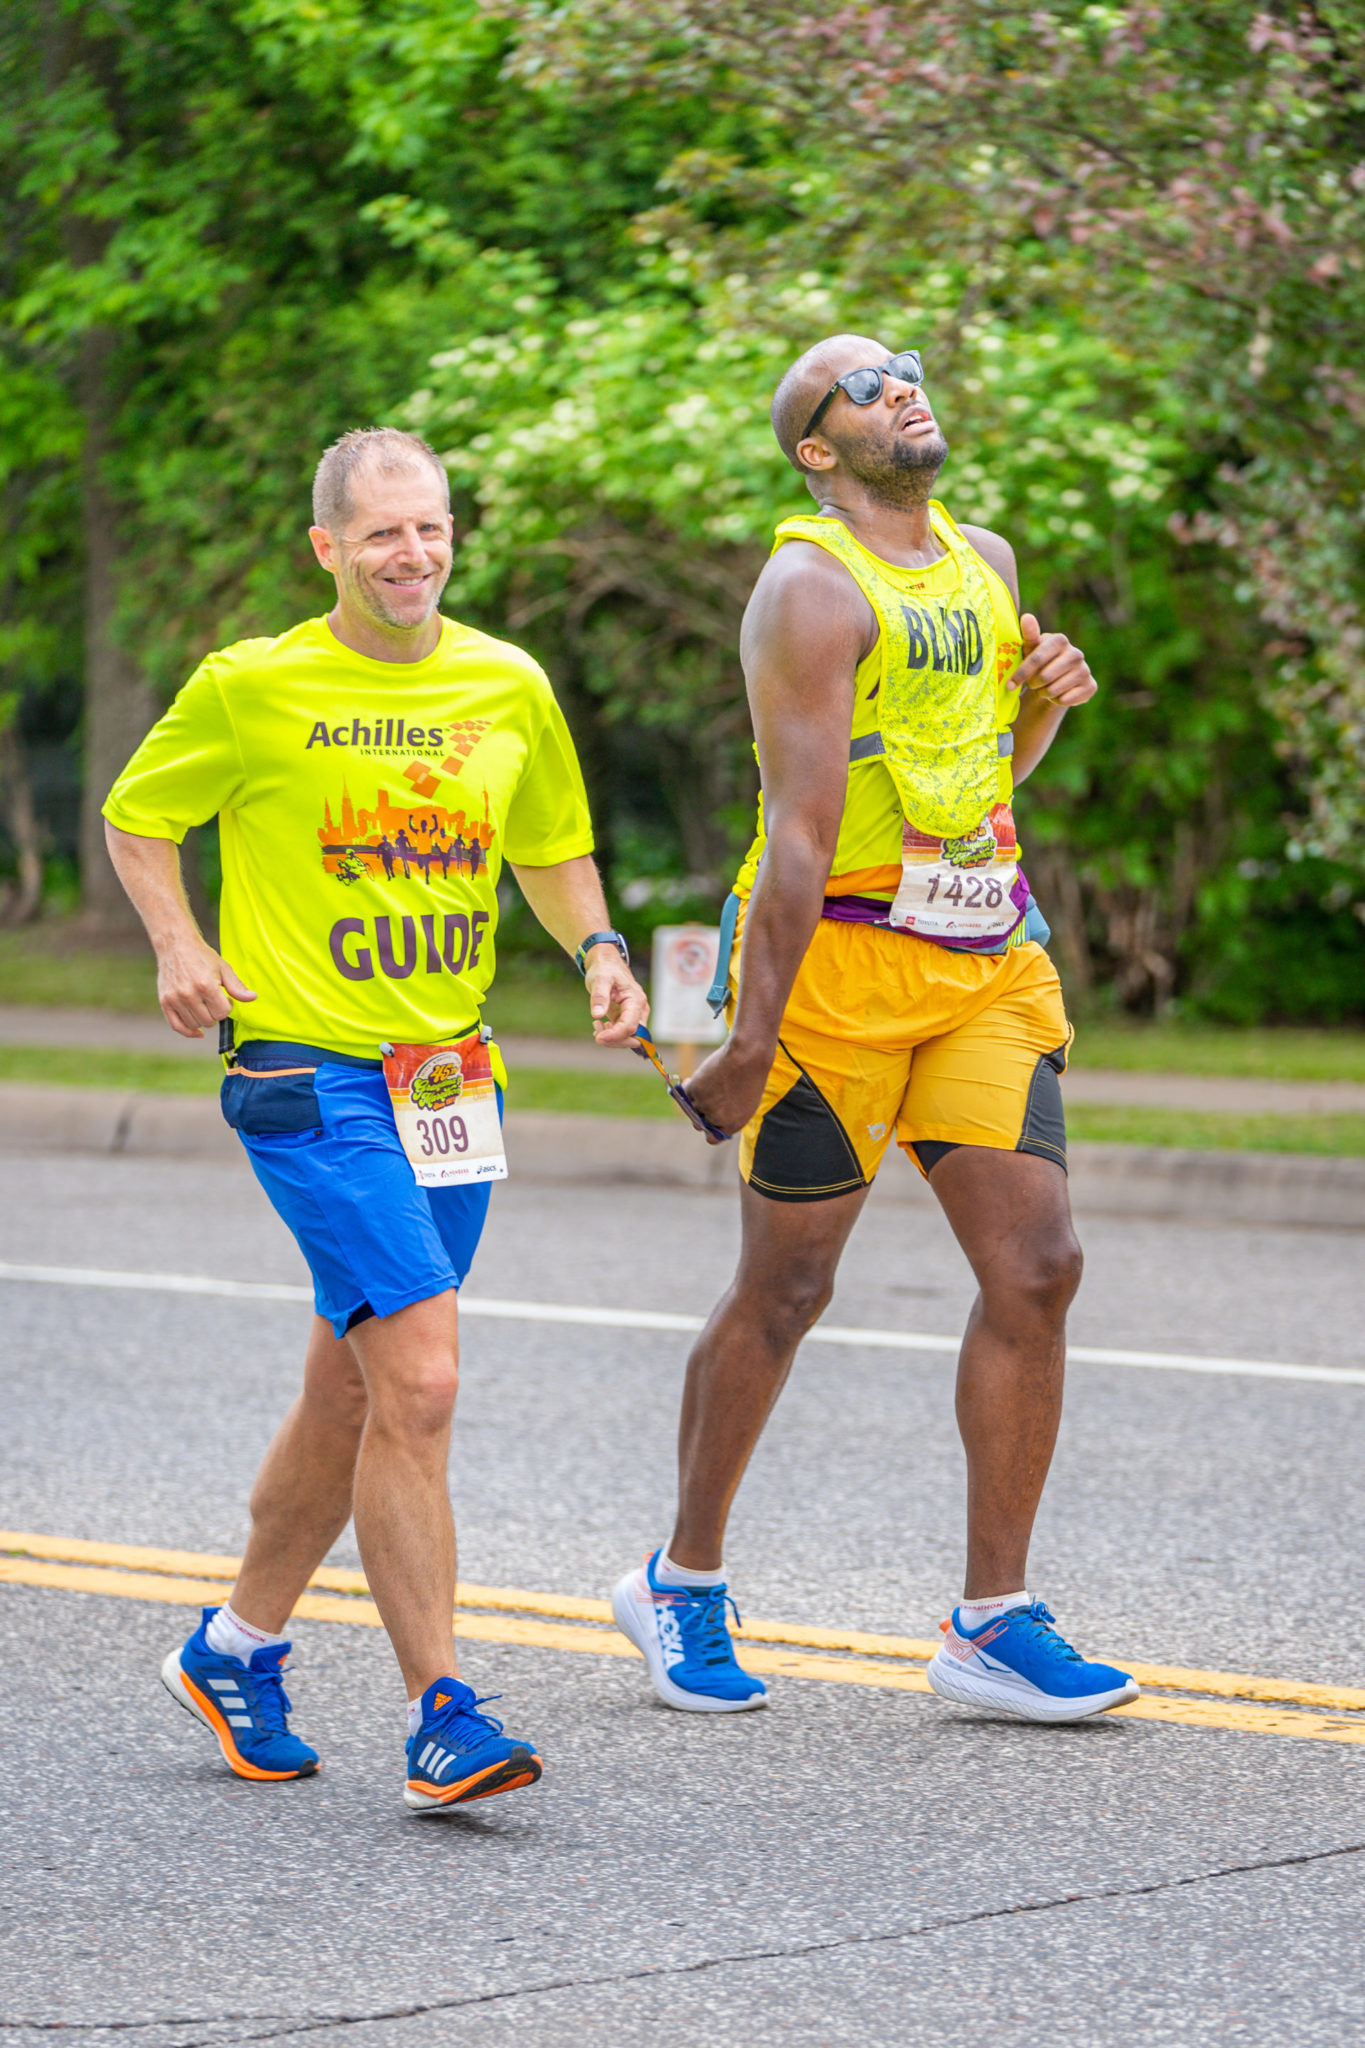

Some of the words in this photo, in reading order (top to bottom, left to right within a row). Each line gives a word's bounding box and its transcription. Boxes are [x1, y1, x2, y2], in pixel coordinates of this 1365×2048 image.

[306, 719, 443, 749] Achilles
[360, 749, 445, 757] INTERNATIONAL
[926, 873, 1003, 908] 1428
[329, 911, 489, 981] GUIDE
[416, 1115, 469, 1156] 309
